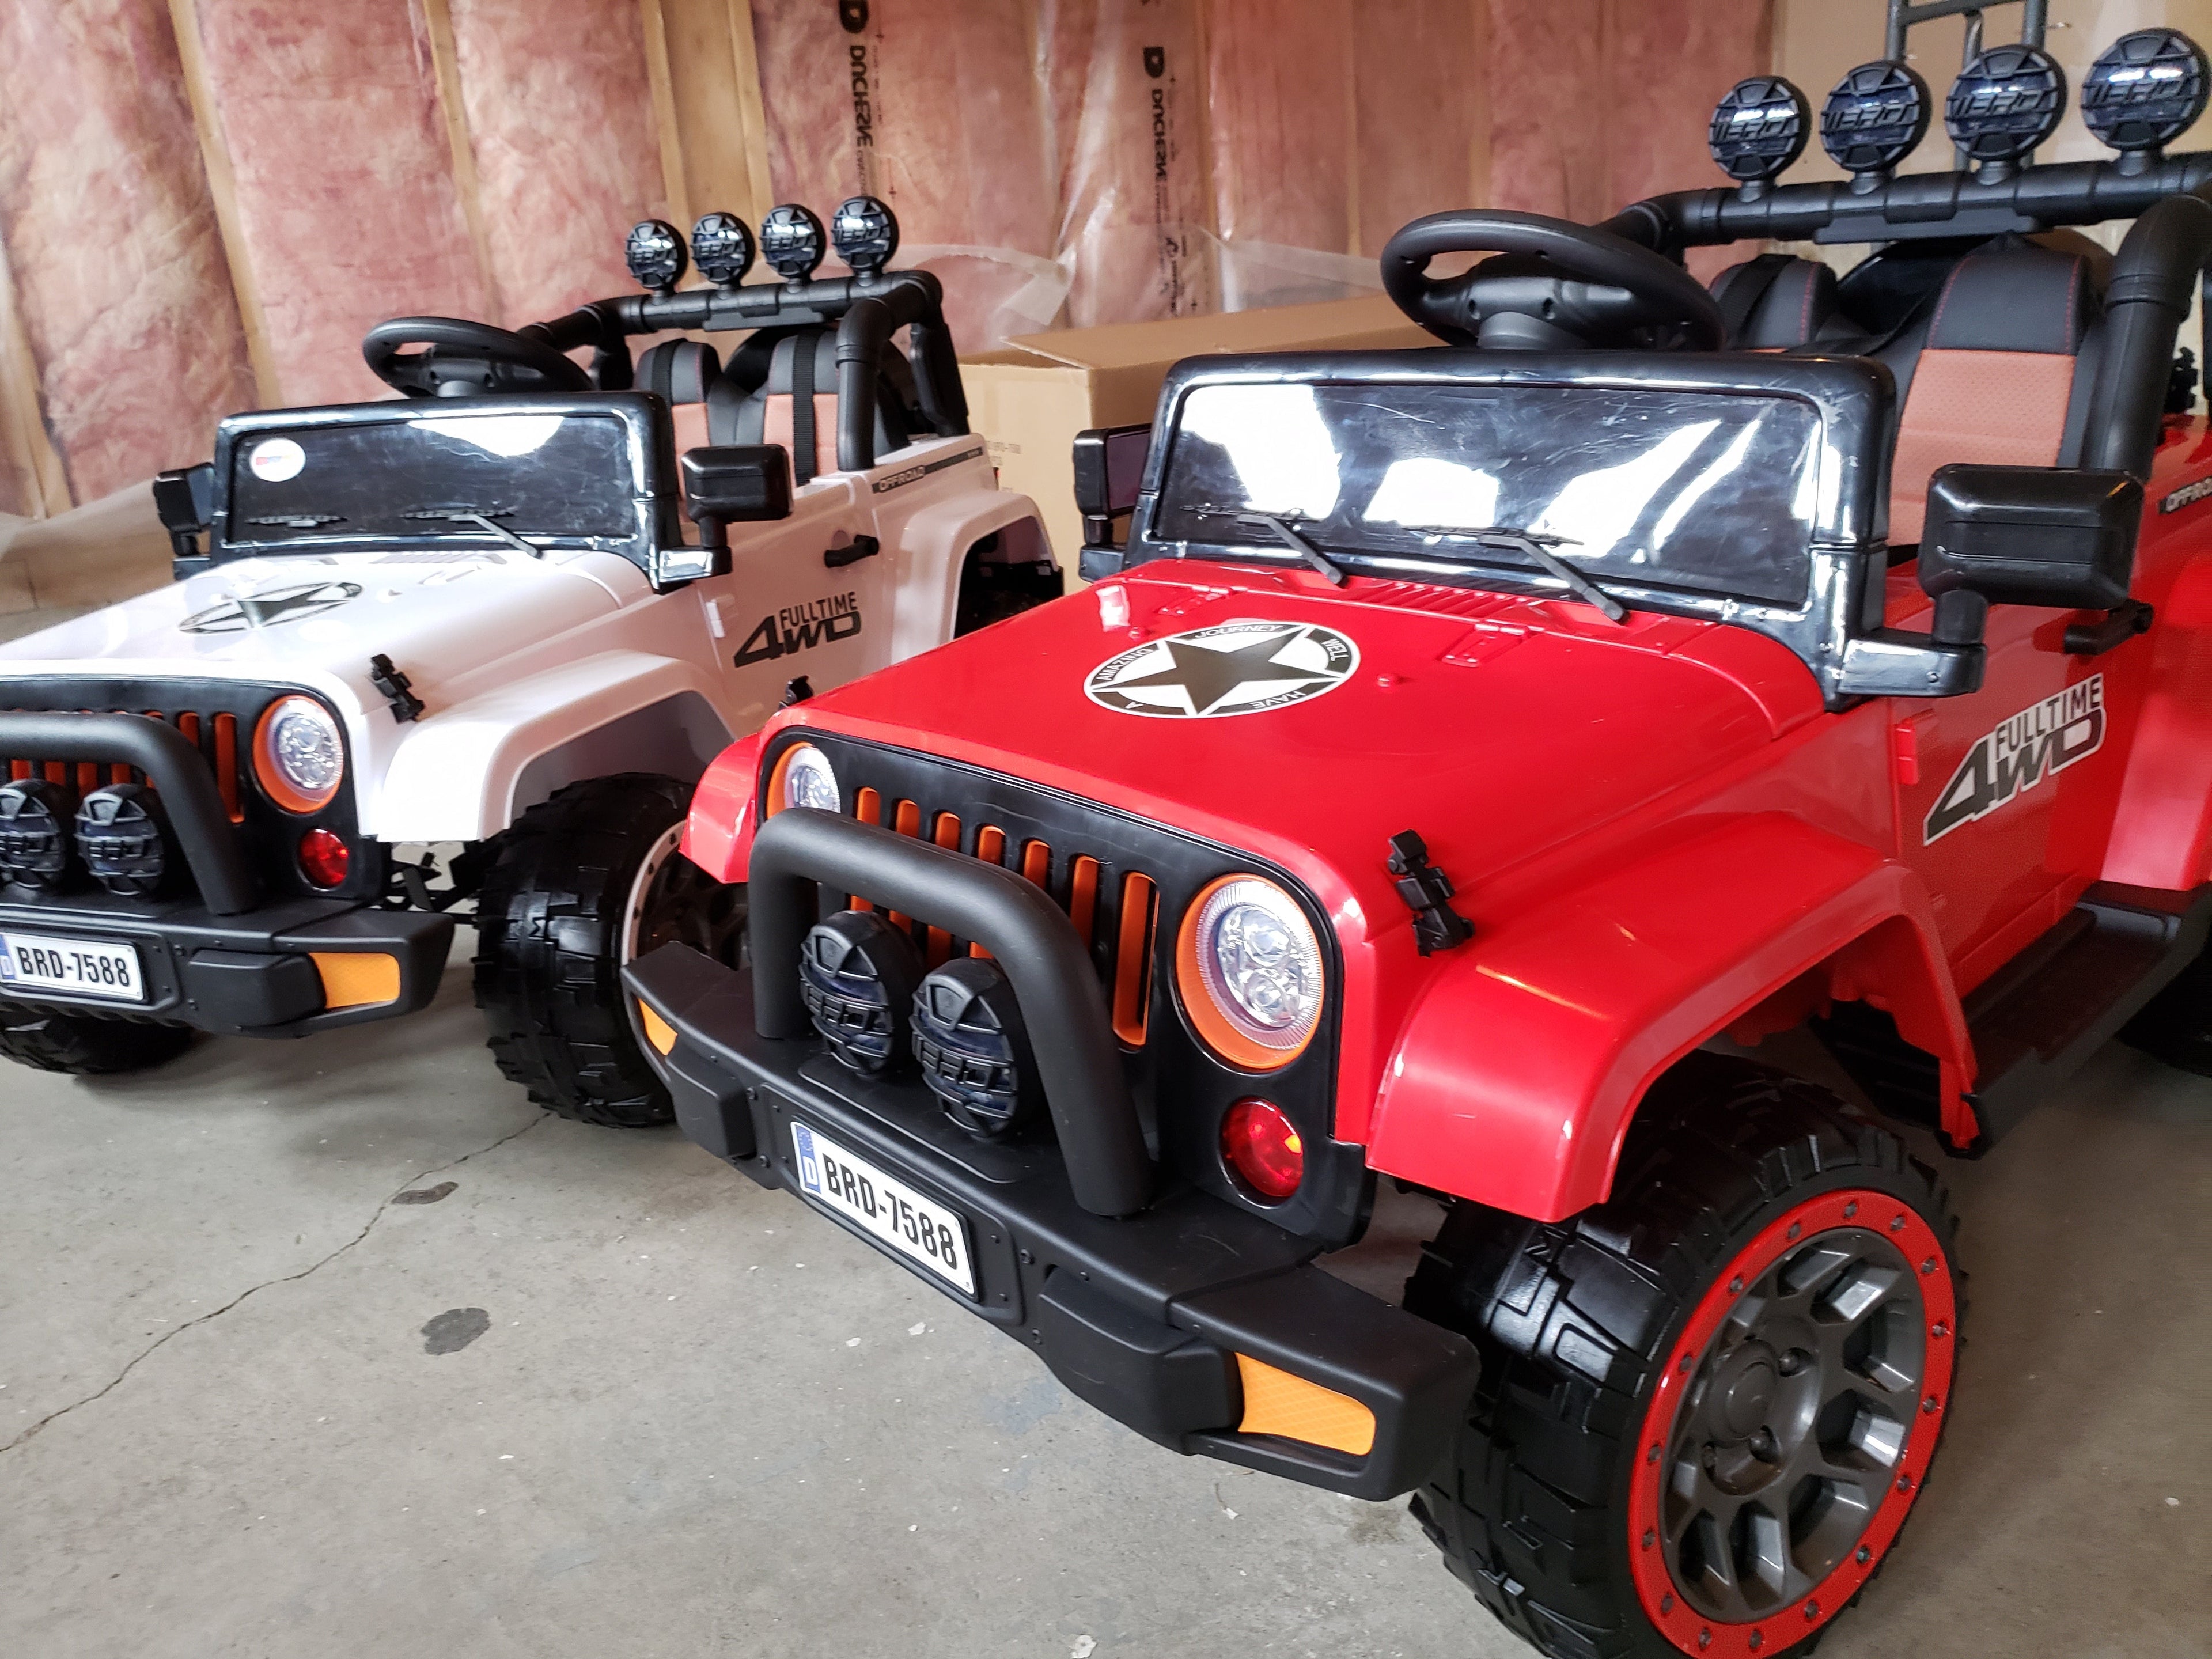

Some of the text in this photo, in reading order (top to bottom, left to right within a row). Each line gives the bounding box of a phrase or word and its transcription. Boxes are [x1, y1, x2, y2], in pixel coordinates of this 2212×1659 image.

[779, 591, 858, 629] FULLTIME
[733, 611, 861, 668] 4WD
[1194, 624, 1284, 638] JOURNEY
[1321, 638, 1349, 662] WELL
[1124, 701, 1144, 709] A
[1249, 691, 1307, 709] HAVE
[1995, 676, 2101, 760] FULLTIME
[1926, 708, 2103, 841] 4WD
[16, 946, 130, 987] BRD-7588
[822, 1153, 957, 1270] BRD-7588
